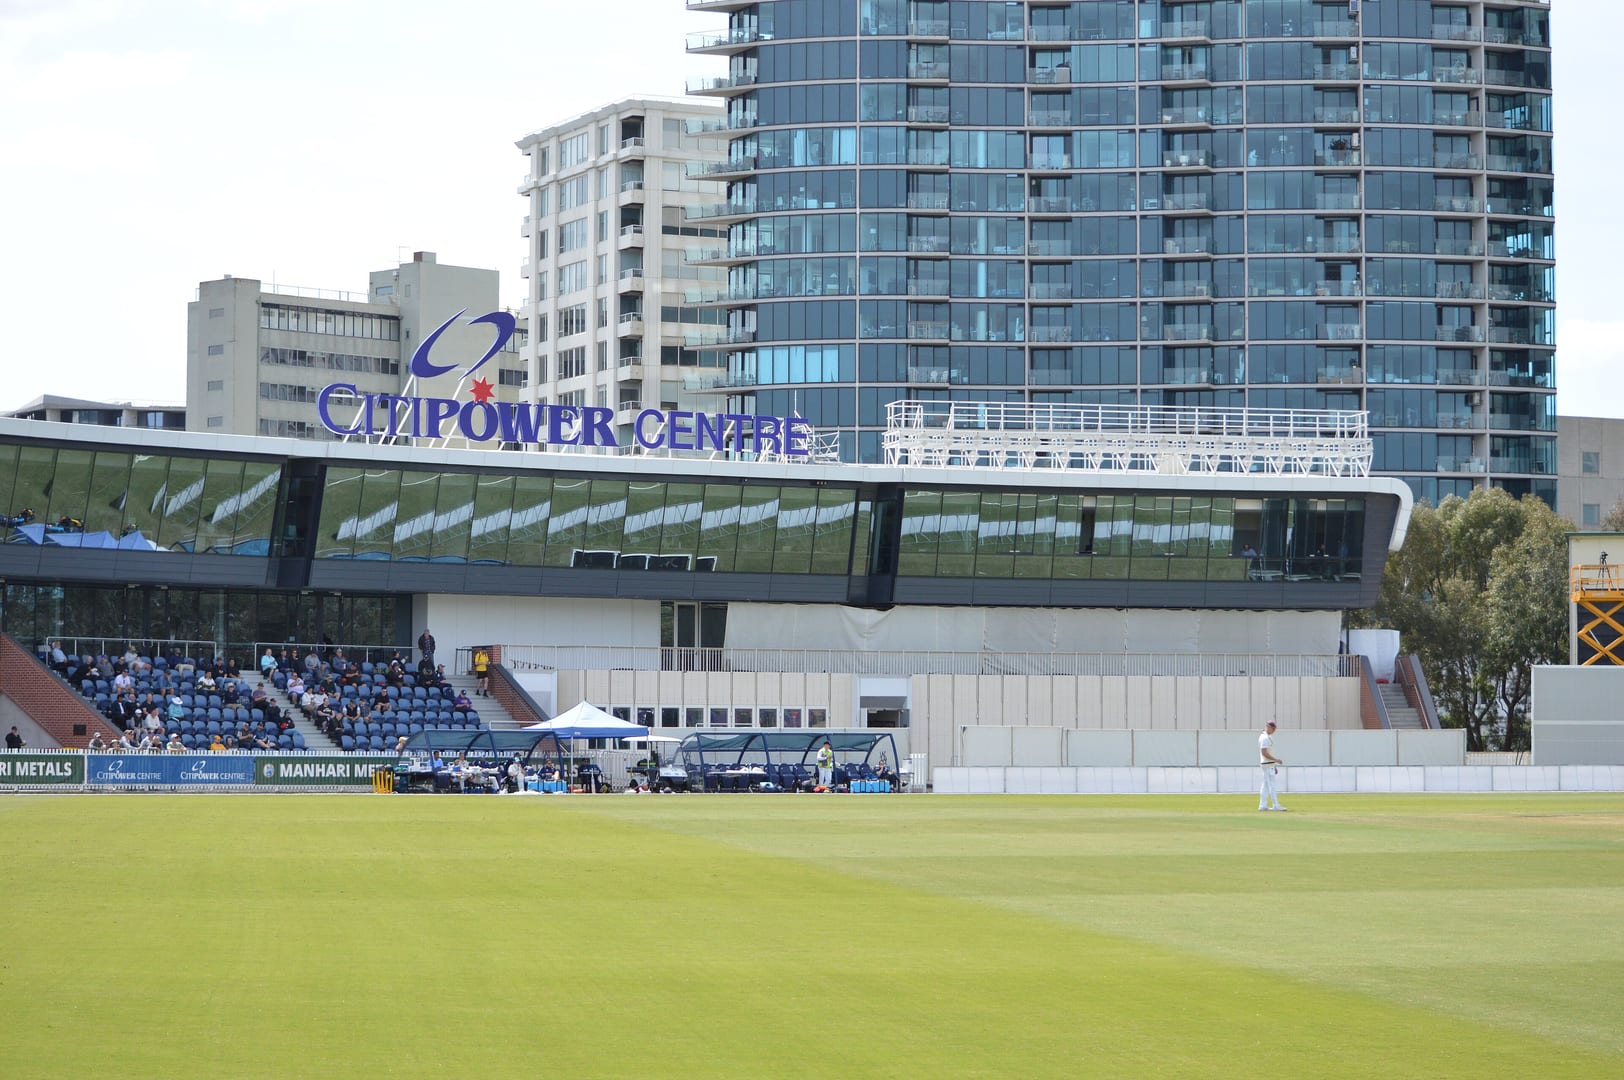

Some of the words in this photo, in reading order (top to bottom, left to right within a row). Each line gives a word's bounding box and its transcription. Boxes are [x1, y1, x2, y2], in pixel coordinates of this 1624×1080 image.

[634, 408, 809, 455] CENTRE
[15, 761, 72, 776] METALS
[137, 772, 162, 780] CENTRE
[220, 772, 245, 780] CENTRE
[280, 763, 350, 778] MANHARI
